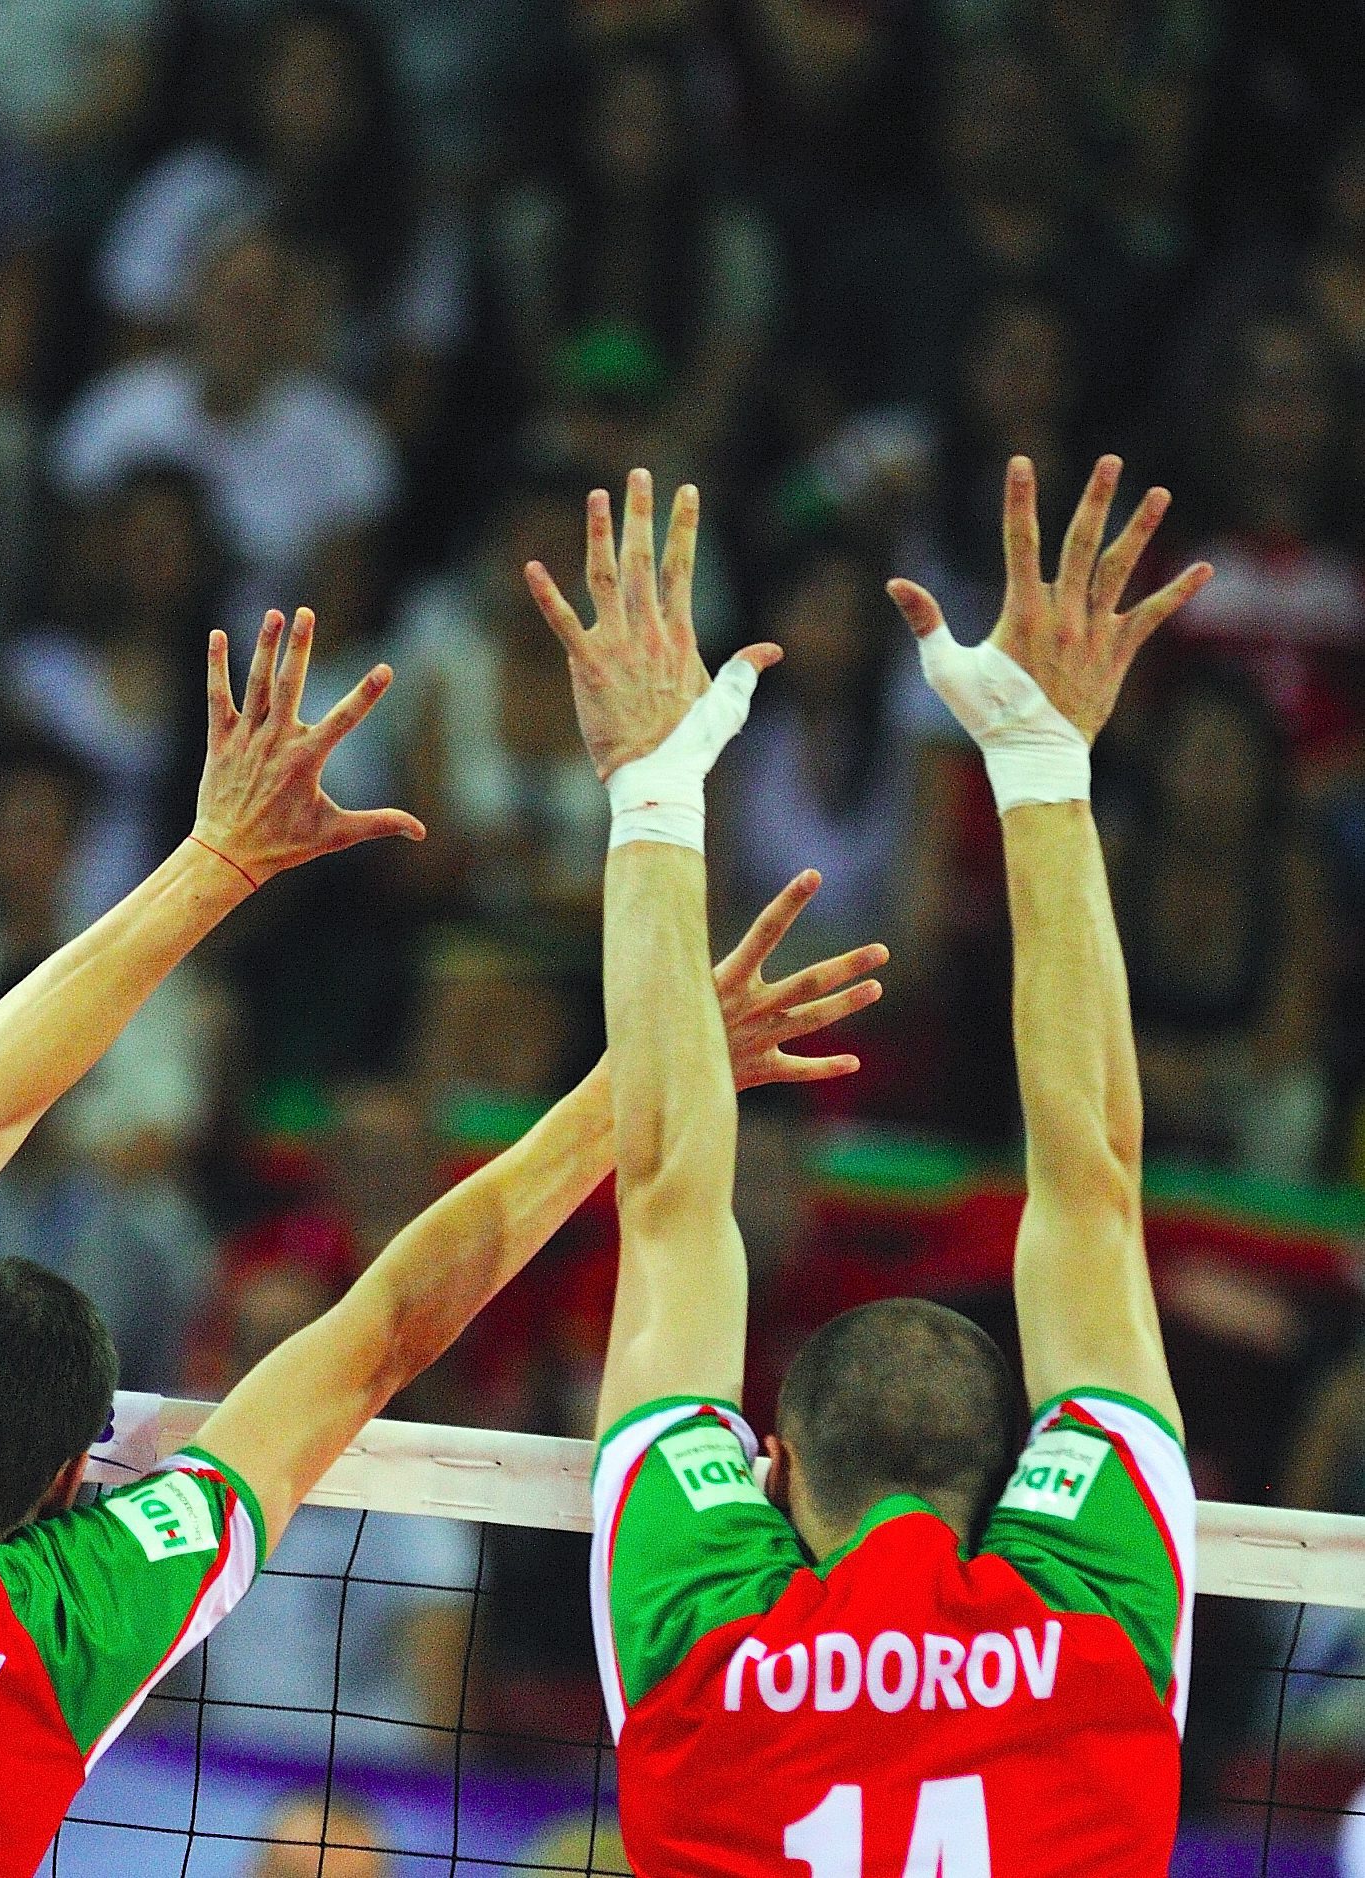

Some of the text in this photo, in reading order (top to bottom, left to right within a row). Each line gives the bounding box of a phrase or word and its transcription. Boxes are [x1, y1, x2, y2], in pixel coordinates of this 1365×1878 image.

[683, 1460, 755, 1491] HDI
[1013, 1465, 1085, 1498] HDI
[129, 1488, 187, 1549] HDI
[724, 1619, 1063, 1713] TODOROV
